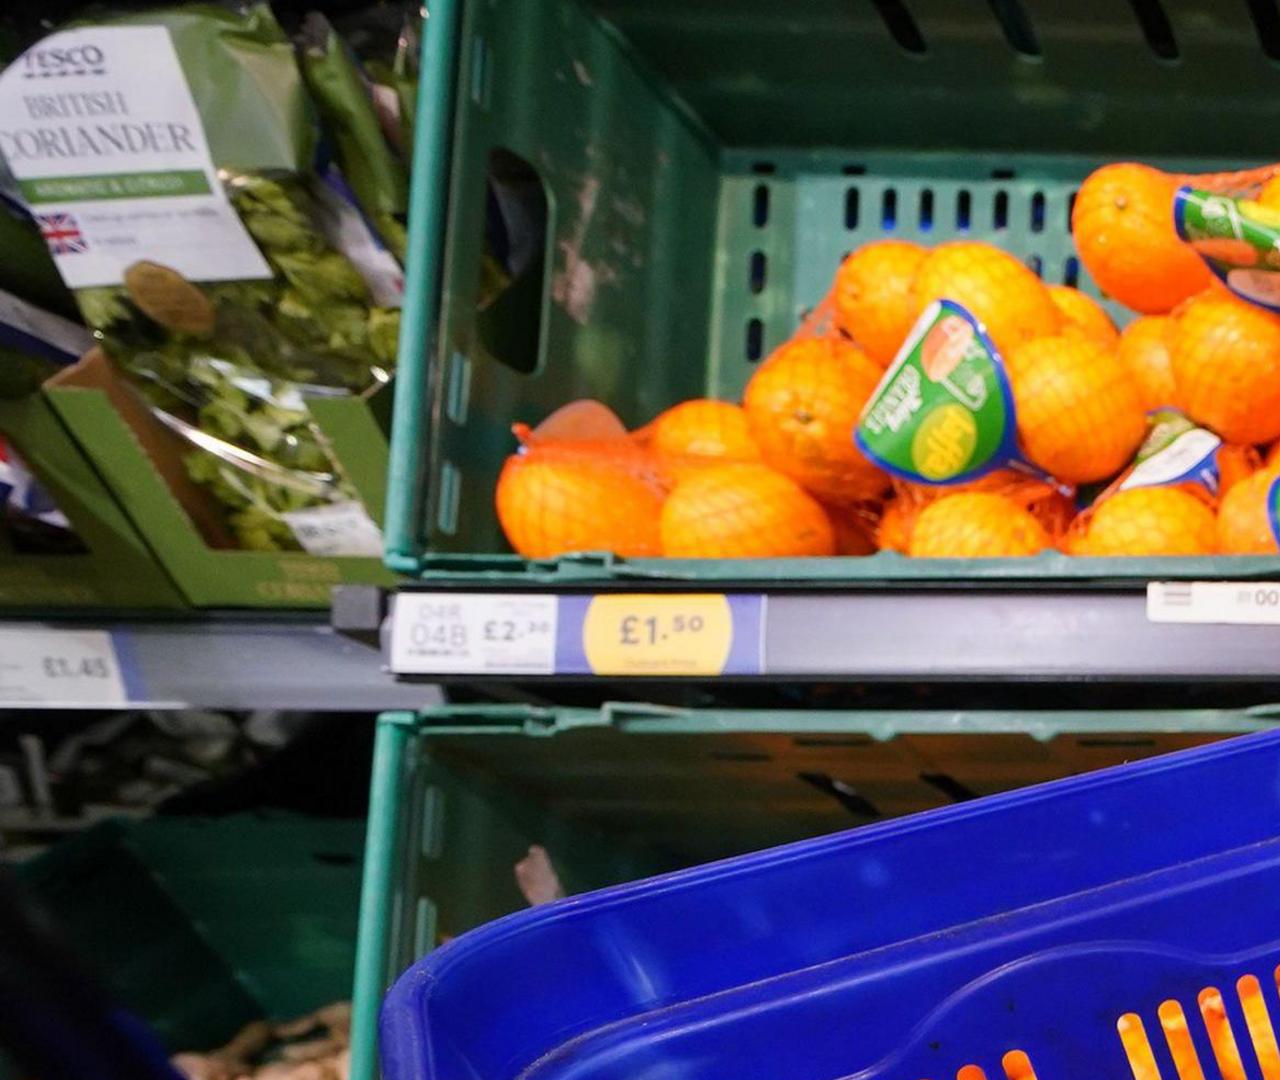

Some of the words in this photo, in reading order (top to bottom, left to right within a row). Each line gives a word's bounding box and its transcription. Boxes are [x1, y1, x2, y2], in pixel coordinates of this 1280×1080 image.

[24, 45, 105, 69] TESCO
[24, 91, 129, 120] BRITISH
[621, 615, 703, 644] £1.50
